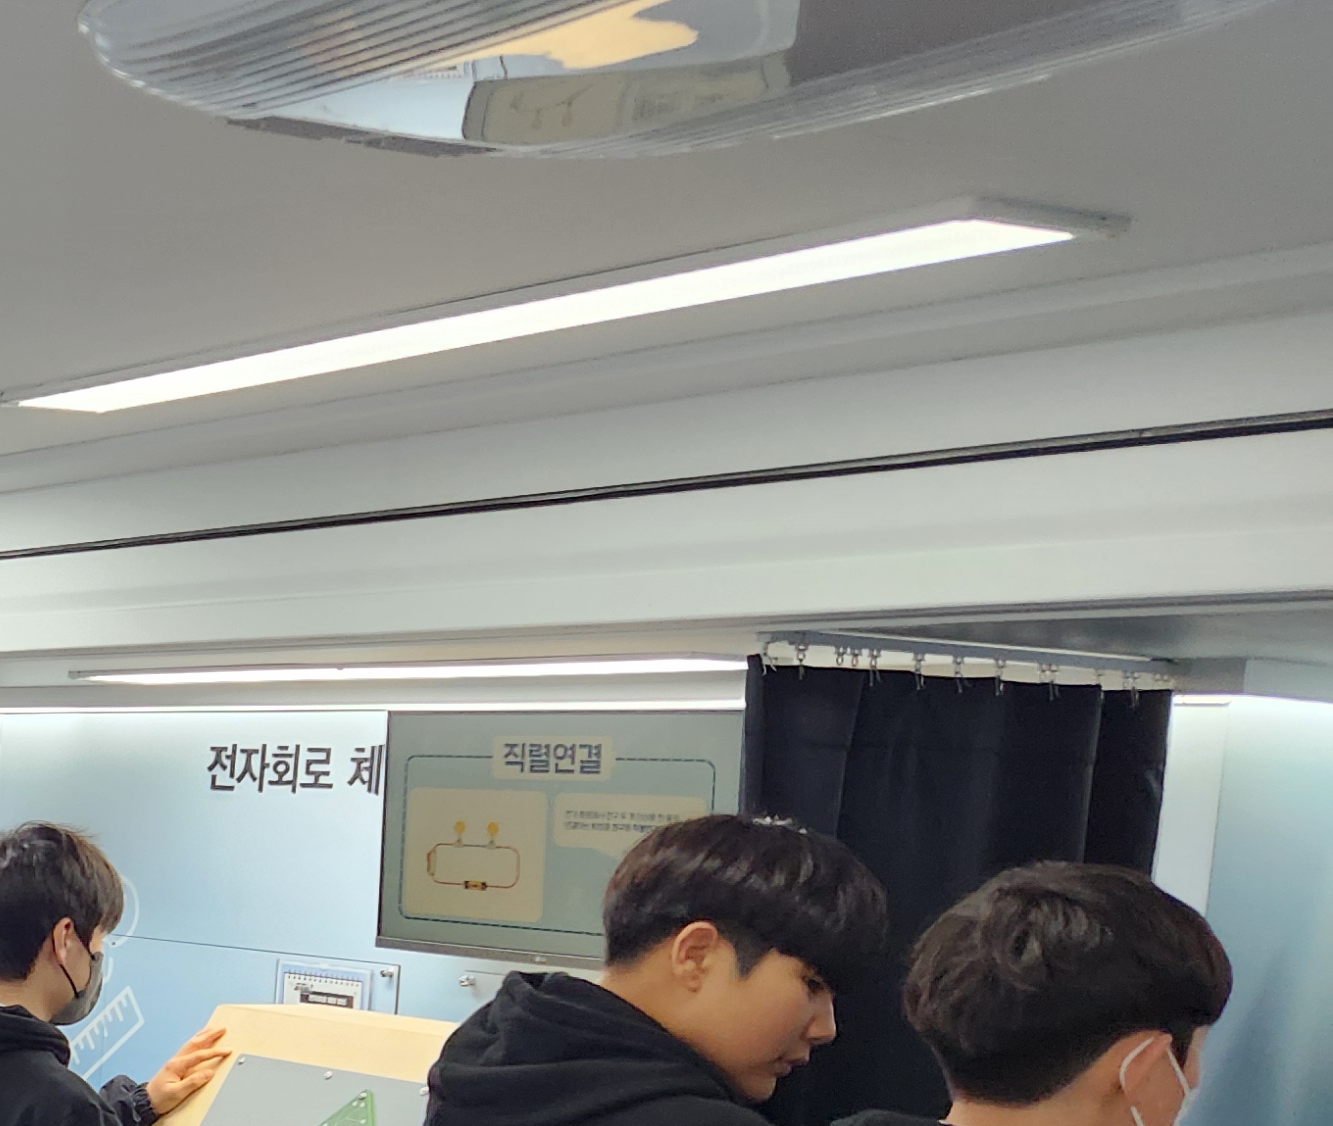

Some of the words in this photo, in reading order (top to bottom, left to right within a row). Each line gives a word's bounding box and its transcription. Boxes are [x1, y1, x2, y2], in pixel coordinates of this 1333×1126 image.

[207, 743, 334, 794] 전자회로
[347, 744, 385, 795] 체
[502, 743, 602, 775] 직렬연결
